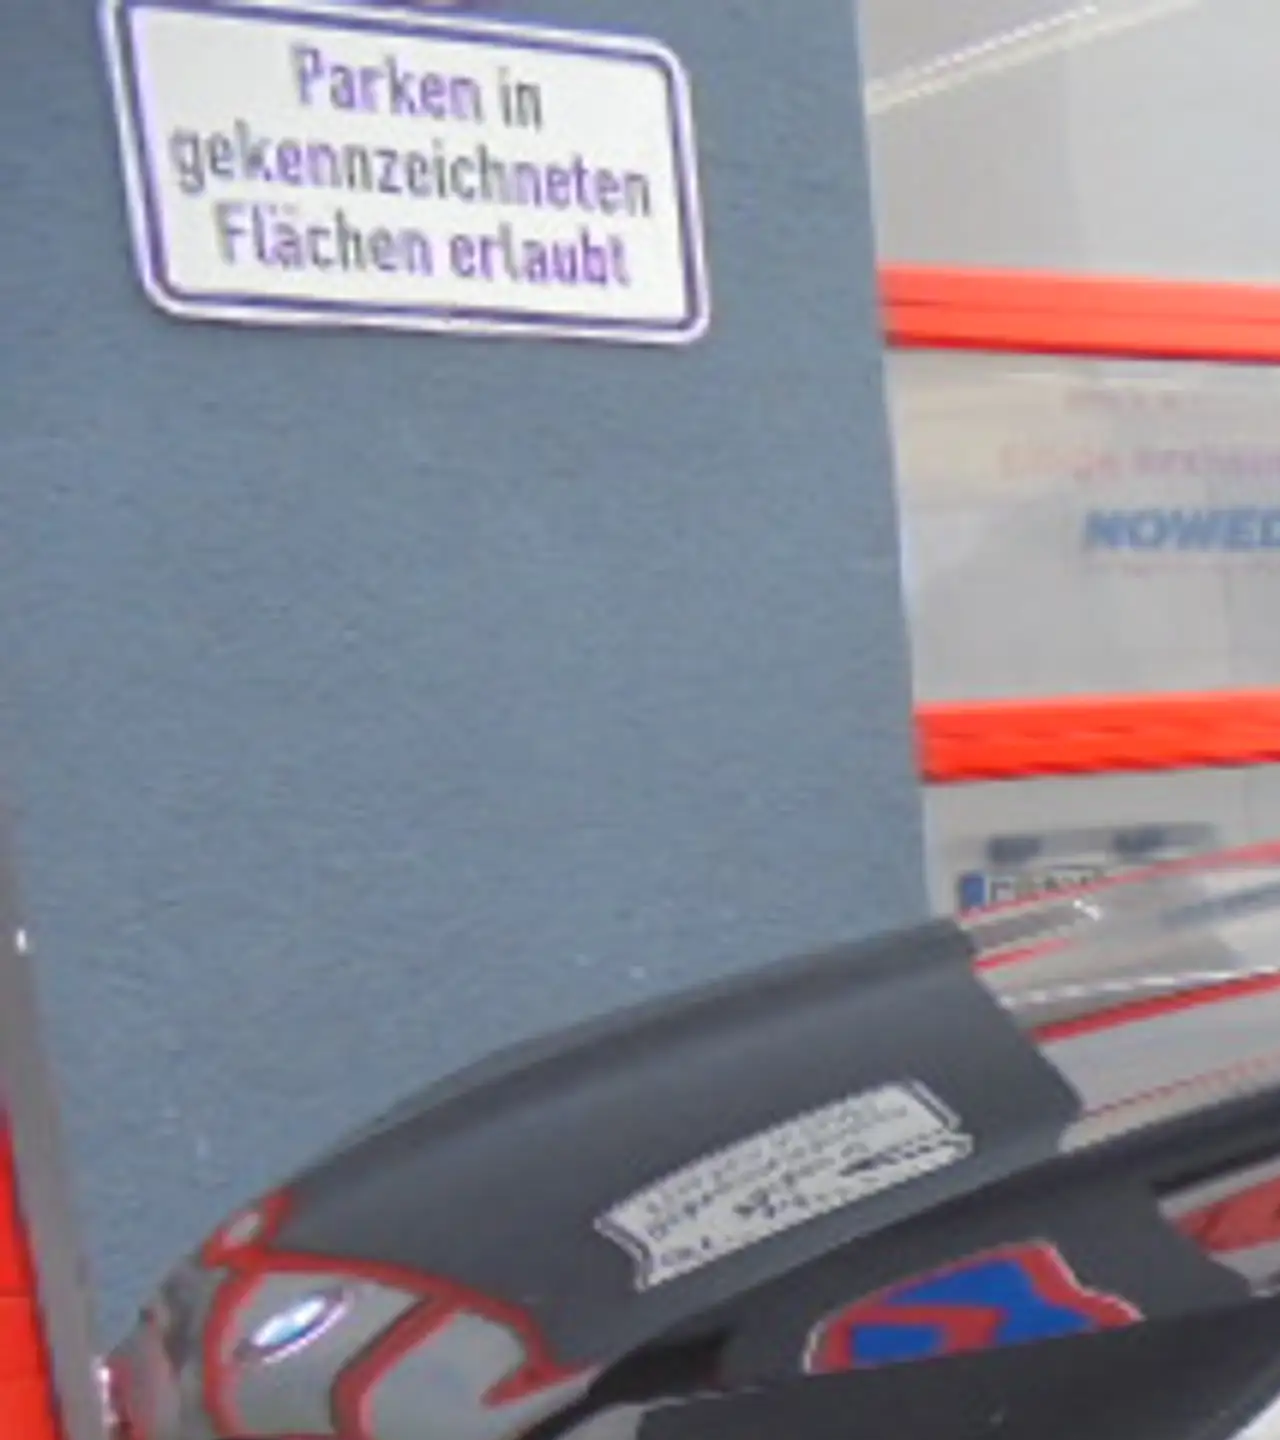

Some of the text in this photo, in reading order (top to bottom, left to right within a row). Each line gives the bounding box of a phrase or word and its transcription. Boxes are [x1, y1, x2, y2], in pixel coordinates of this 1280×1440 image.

[291, 45, 544, 130] Parken in
[168, 120, 653, 218] gekennzeichneten
[213, 201, 633, 287] Flächen erlaubt
